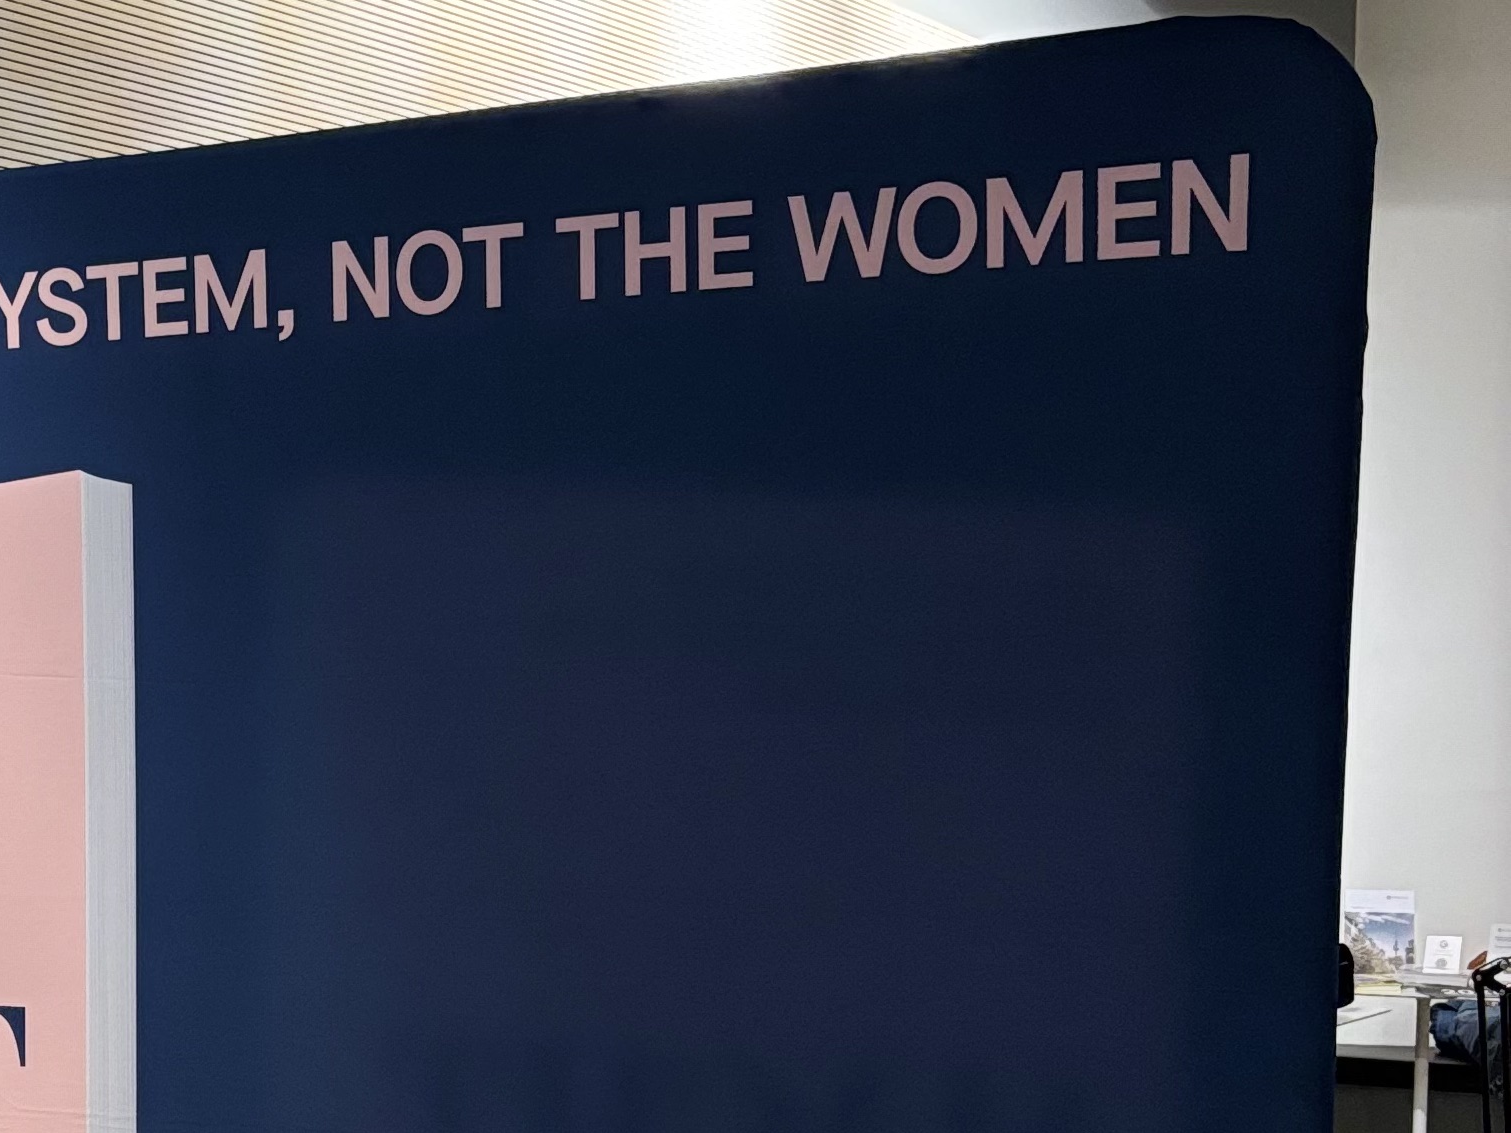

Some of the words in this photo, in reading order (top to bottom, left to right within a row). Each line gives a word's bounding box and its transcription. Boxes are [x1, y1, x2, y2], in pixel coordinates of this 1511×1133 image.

[332, 222, 524, 322] NOT
[556, 200, 754, 300] THE
[787, 153, 1251, 282] WOMEN
